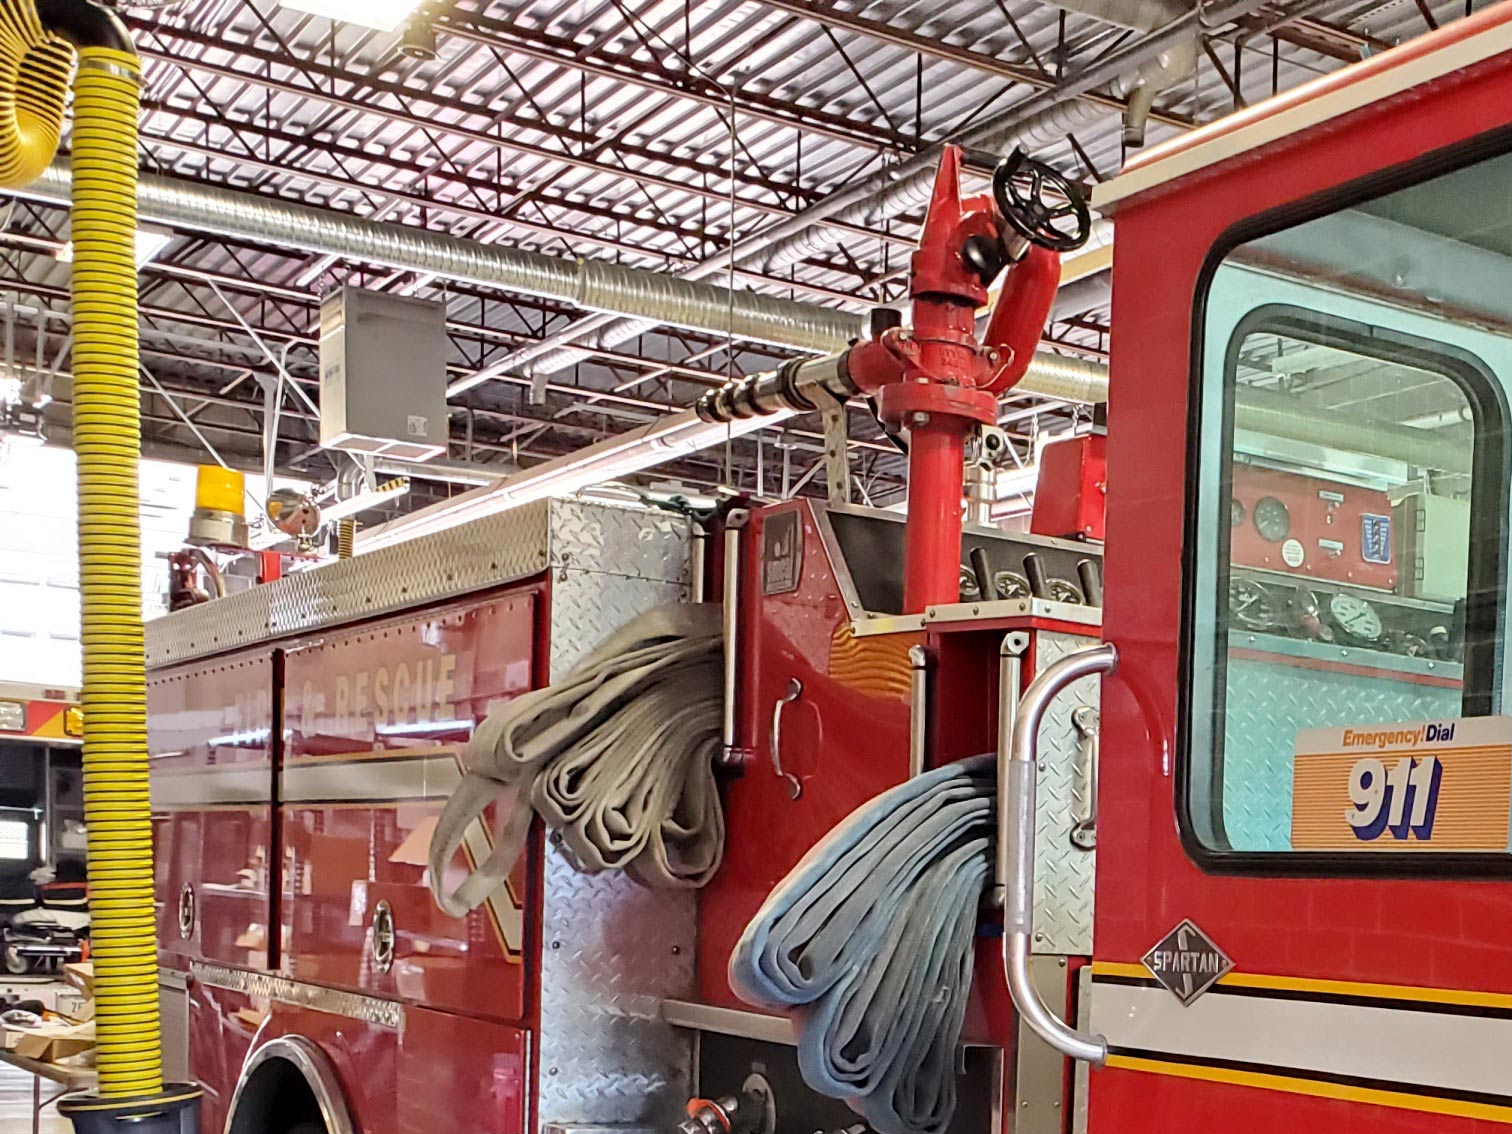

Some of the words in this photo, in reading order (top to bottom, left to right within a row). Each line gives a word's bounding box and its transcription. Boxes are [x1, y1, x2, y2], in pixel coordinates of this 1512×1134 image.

[335, 653, 457, 734] RESCUE
[1425, 722, 1456, 743] Dial
[1344, 755, 1443, 841] 911
[1152, 950, 1220, 974] SPARTAN
